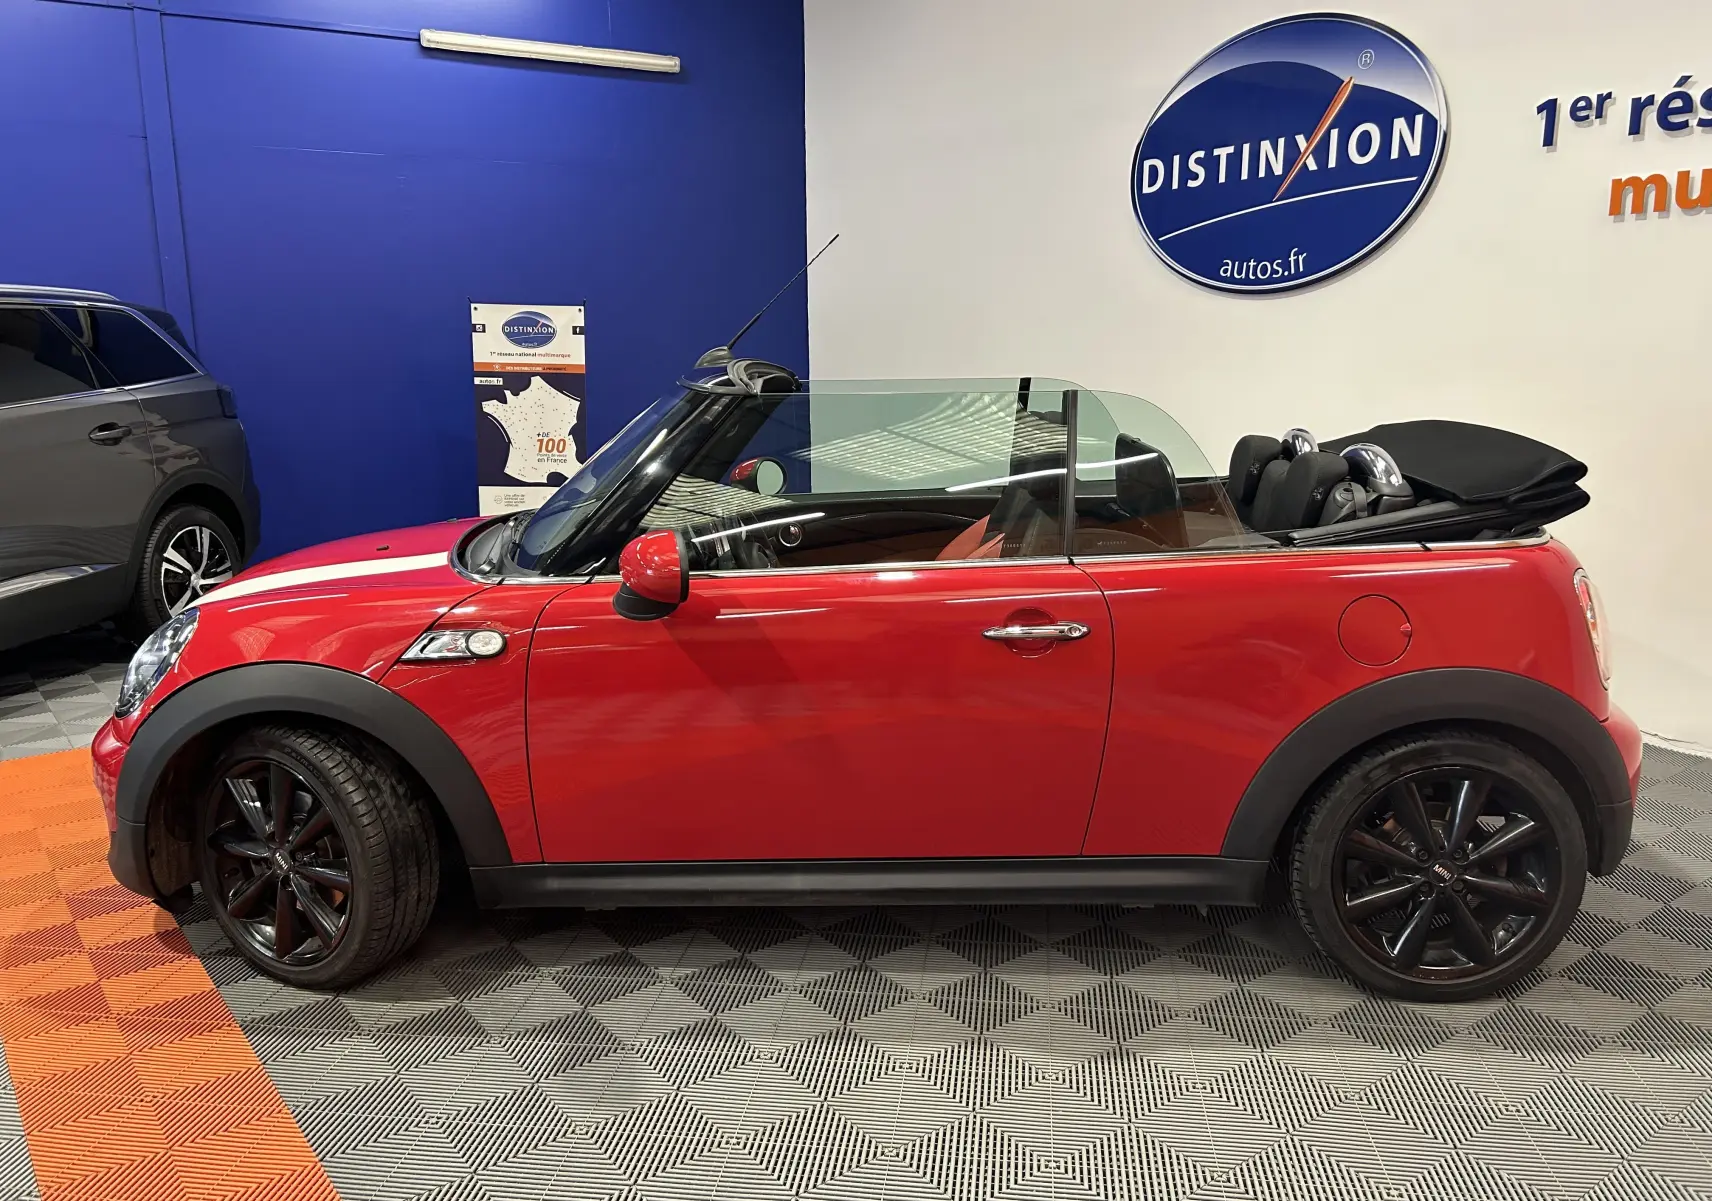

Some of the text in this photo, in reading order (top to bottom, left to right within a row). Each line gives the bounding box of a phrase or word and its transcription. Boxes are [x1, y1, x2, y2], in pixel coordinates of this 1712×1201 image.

[1536, 91, 1613, 147] 1er
[1141, 113, 1424, 194] DISTINXION
[1608, 168, 1712, 216] mu
[1219, 248, 1307, 280] autos.fr
[504, 326, 554, 334] DISTINXION
[536, 438, 567, 453] 100
[275, 852, 288, 870] MINI
[1433, 864, 1452, 880] MINI
